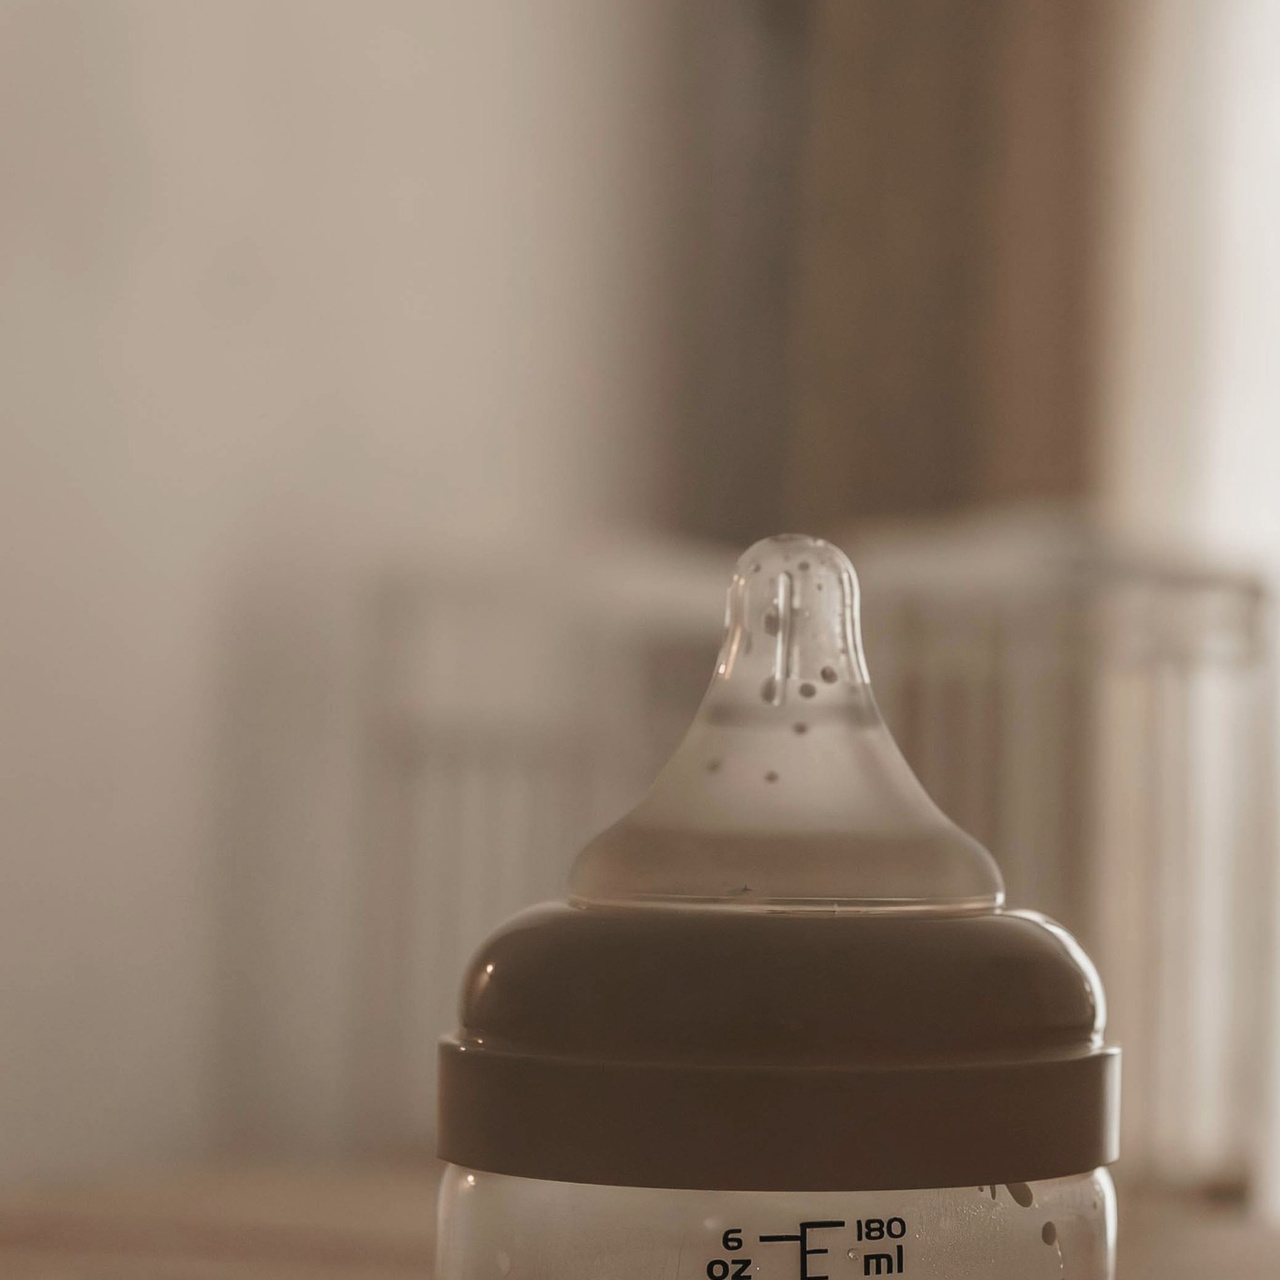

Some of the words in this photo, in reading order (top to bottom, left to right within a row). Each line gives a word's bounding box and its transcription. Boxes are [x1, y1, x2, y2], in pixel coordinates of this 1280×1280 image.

[721, 1228, 743, 1251] 6
[856, 1217, 907, 1242] 180
[863, 1245, 904, 1276] ml
